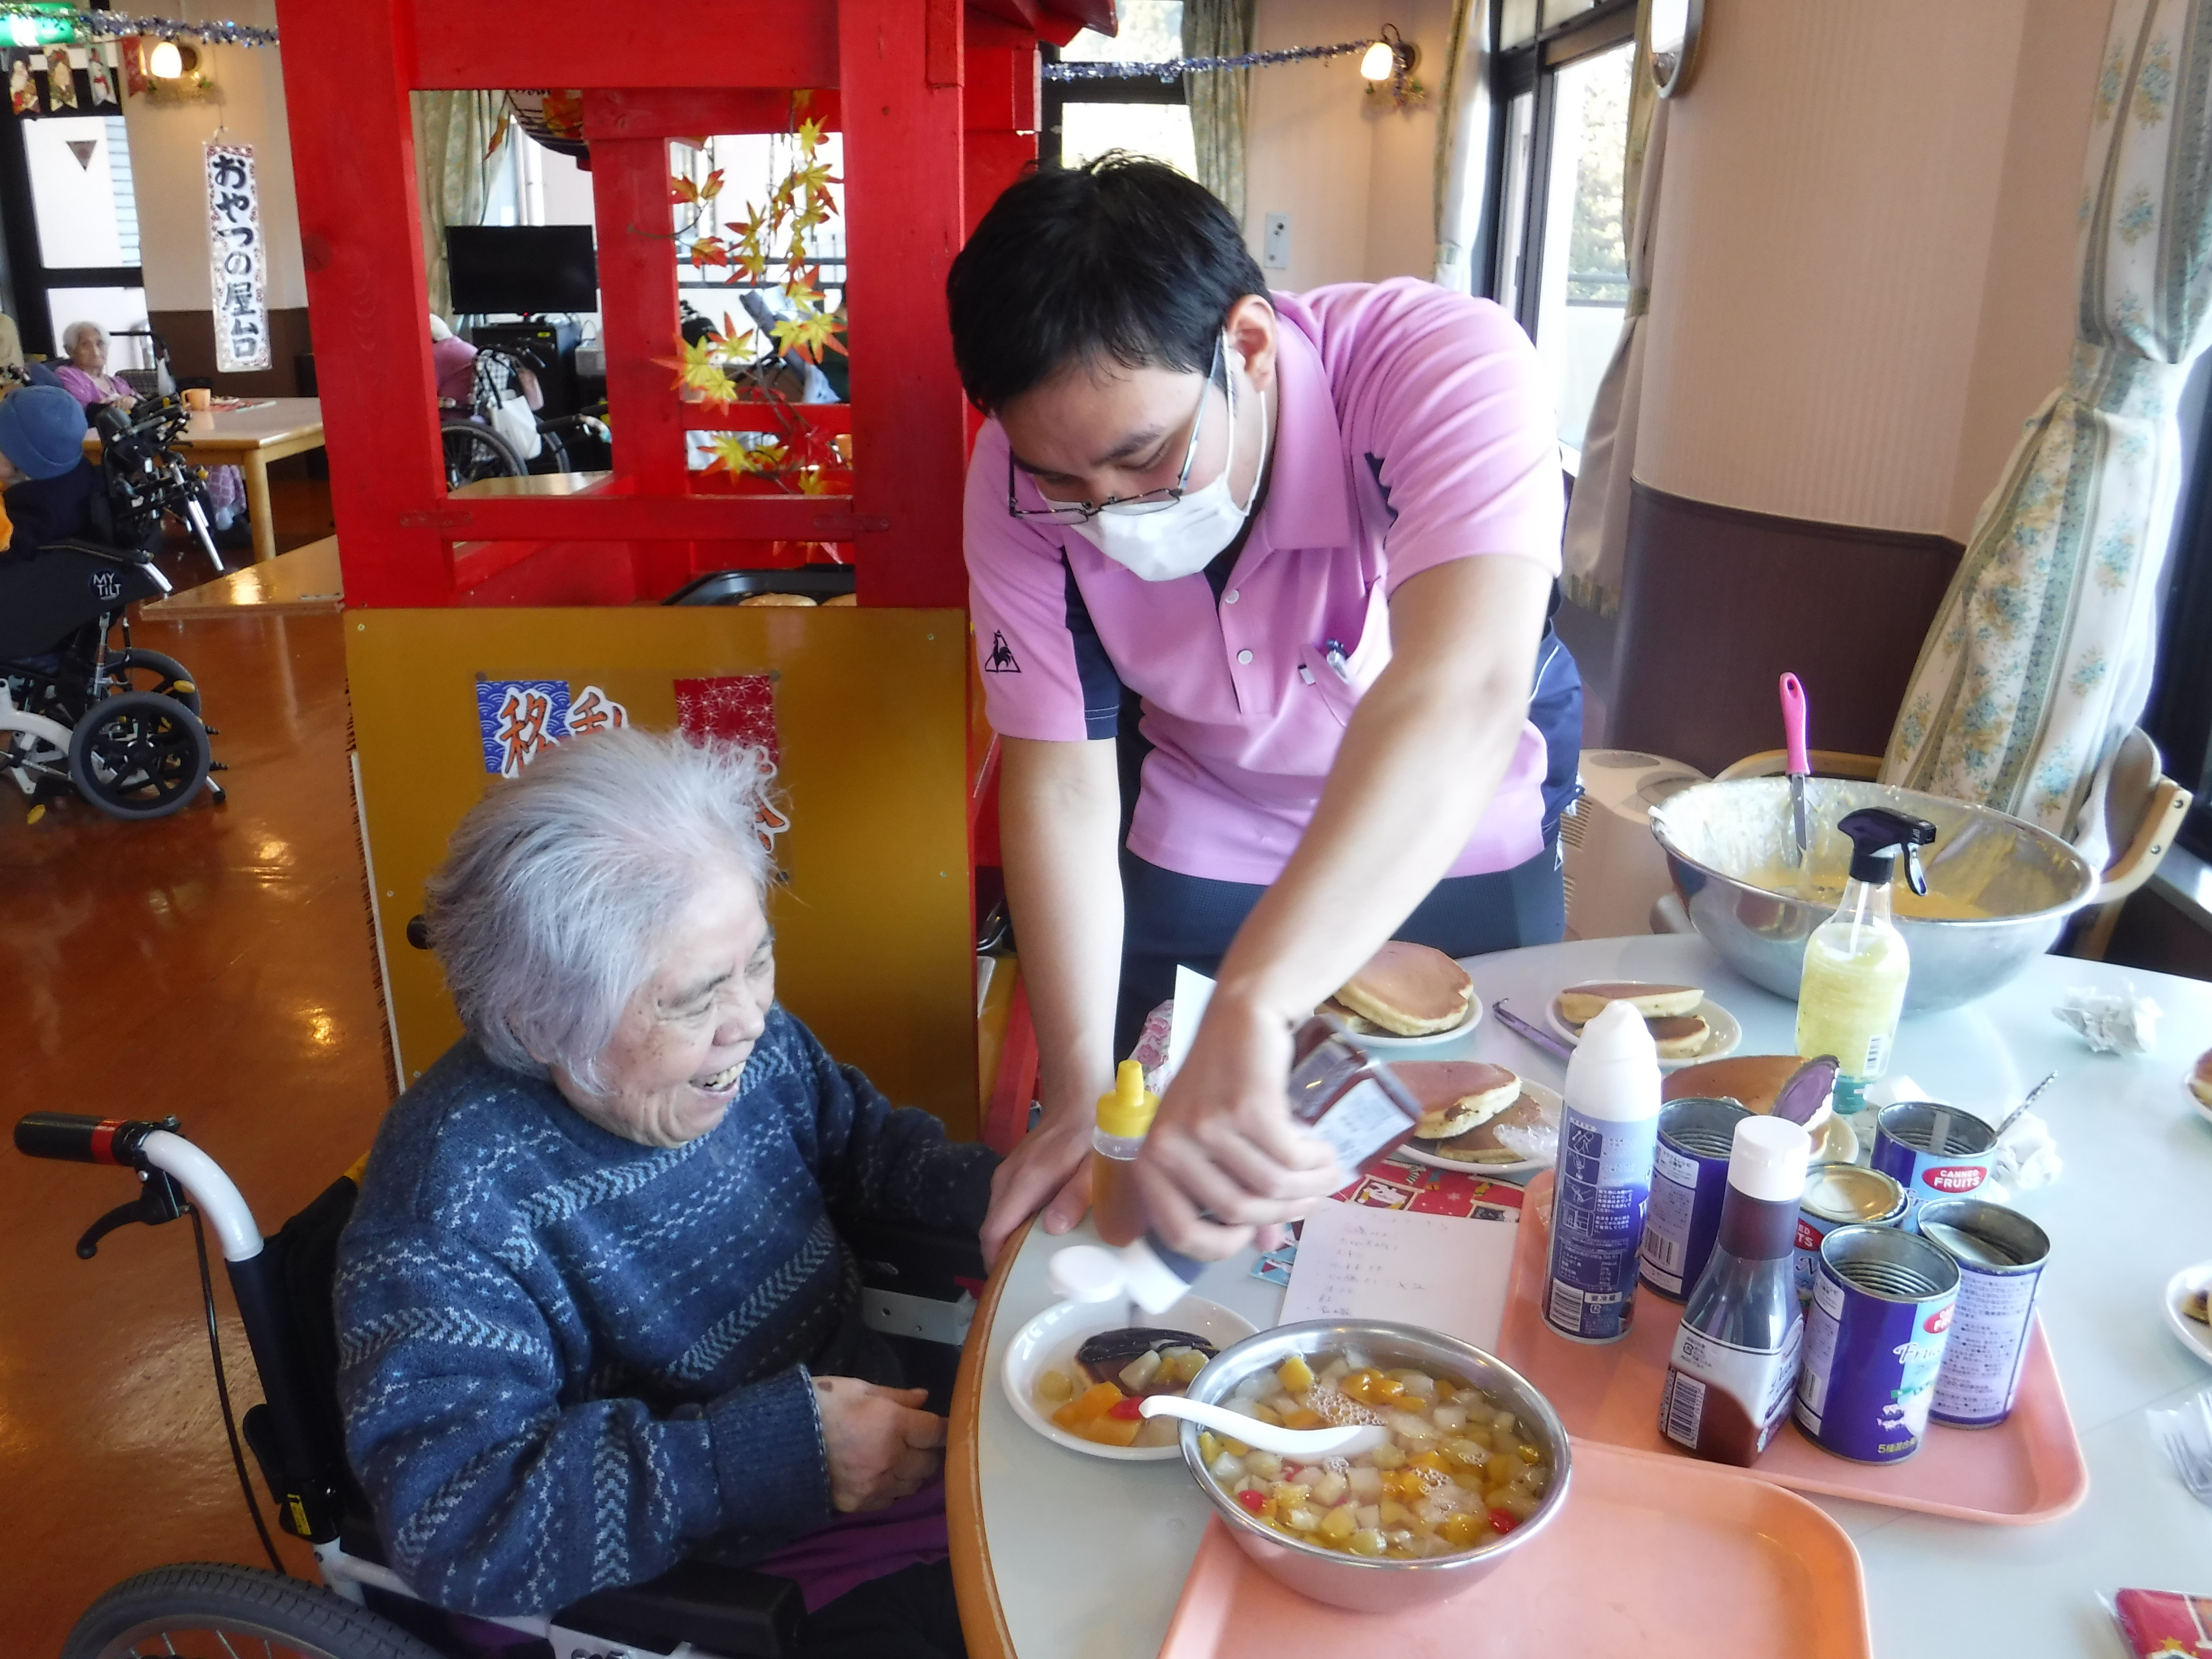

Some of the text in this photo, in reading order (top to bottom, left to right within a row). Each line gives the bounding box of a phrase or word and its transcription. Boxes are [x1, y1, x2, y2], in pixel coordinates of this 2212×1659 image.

[213, 155, 259, 360] おやつの屋台
[93, 572, 115, 585] MY
[1940, 1169, 1980, 1178] CANNED
[1933, 1177, 1981, 1189] FRUITS
